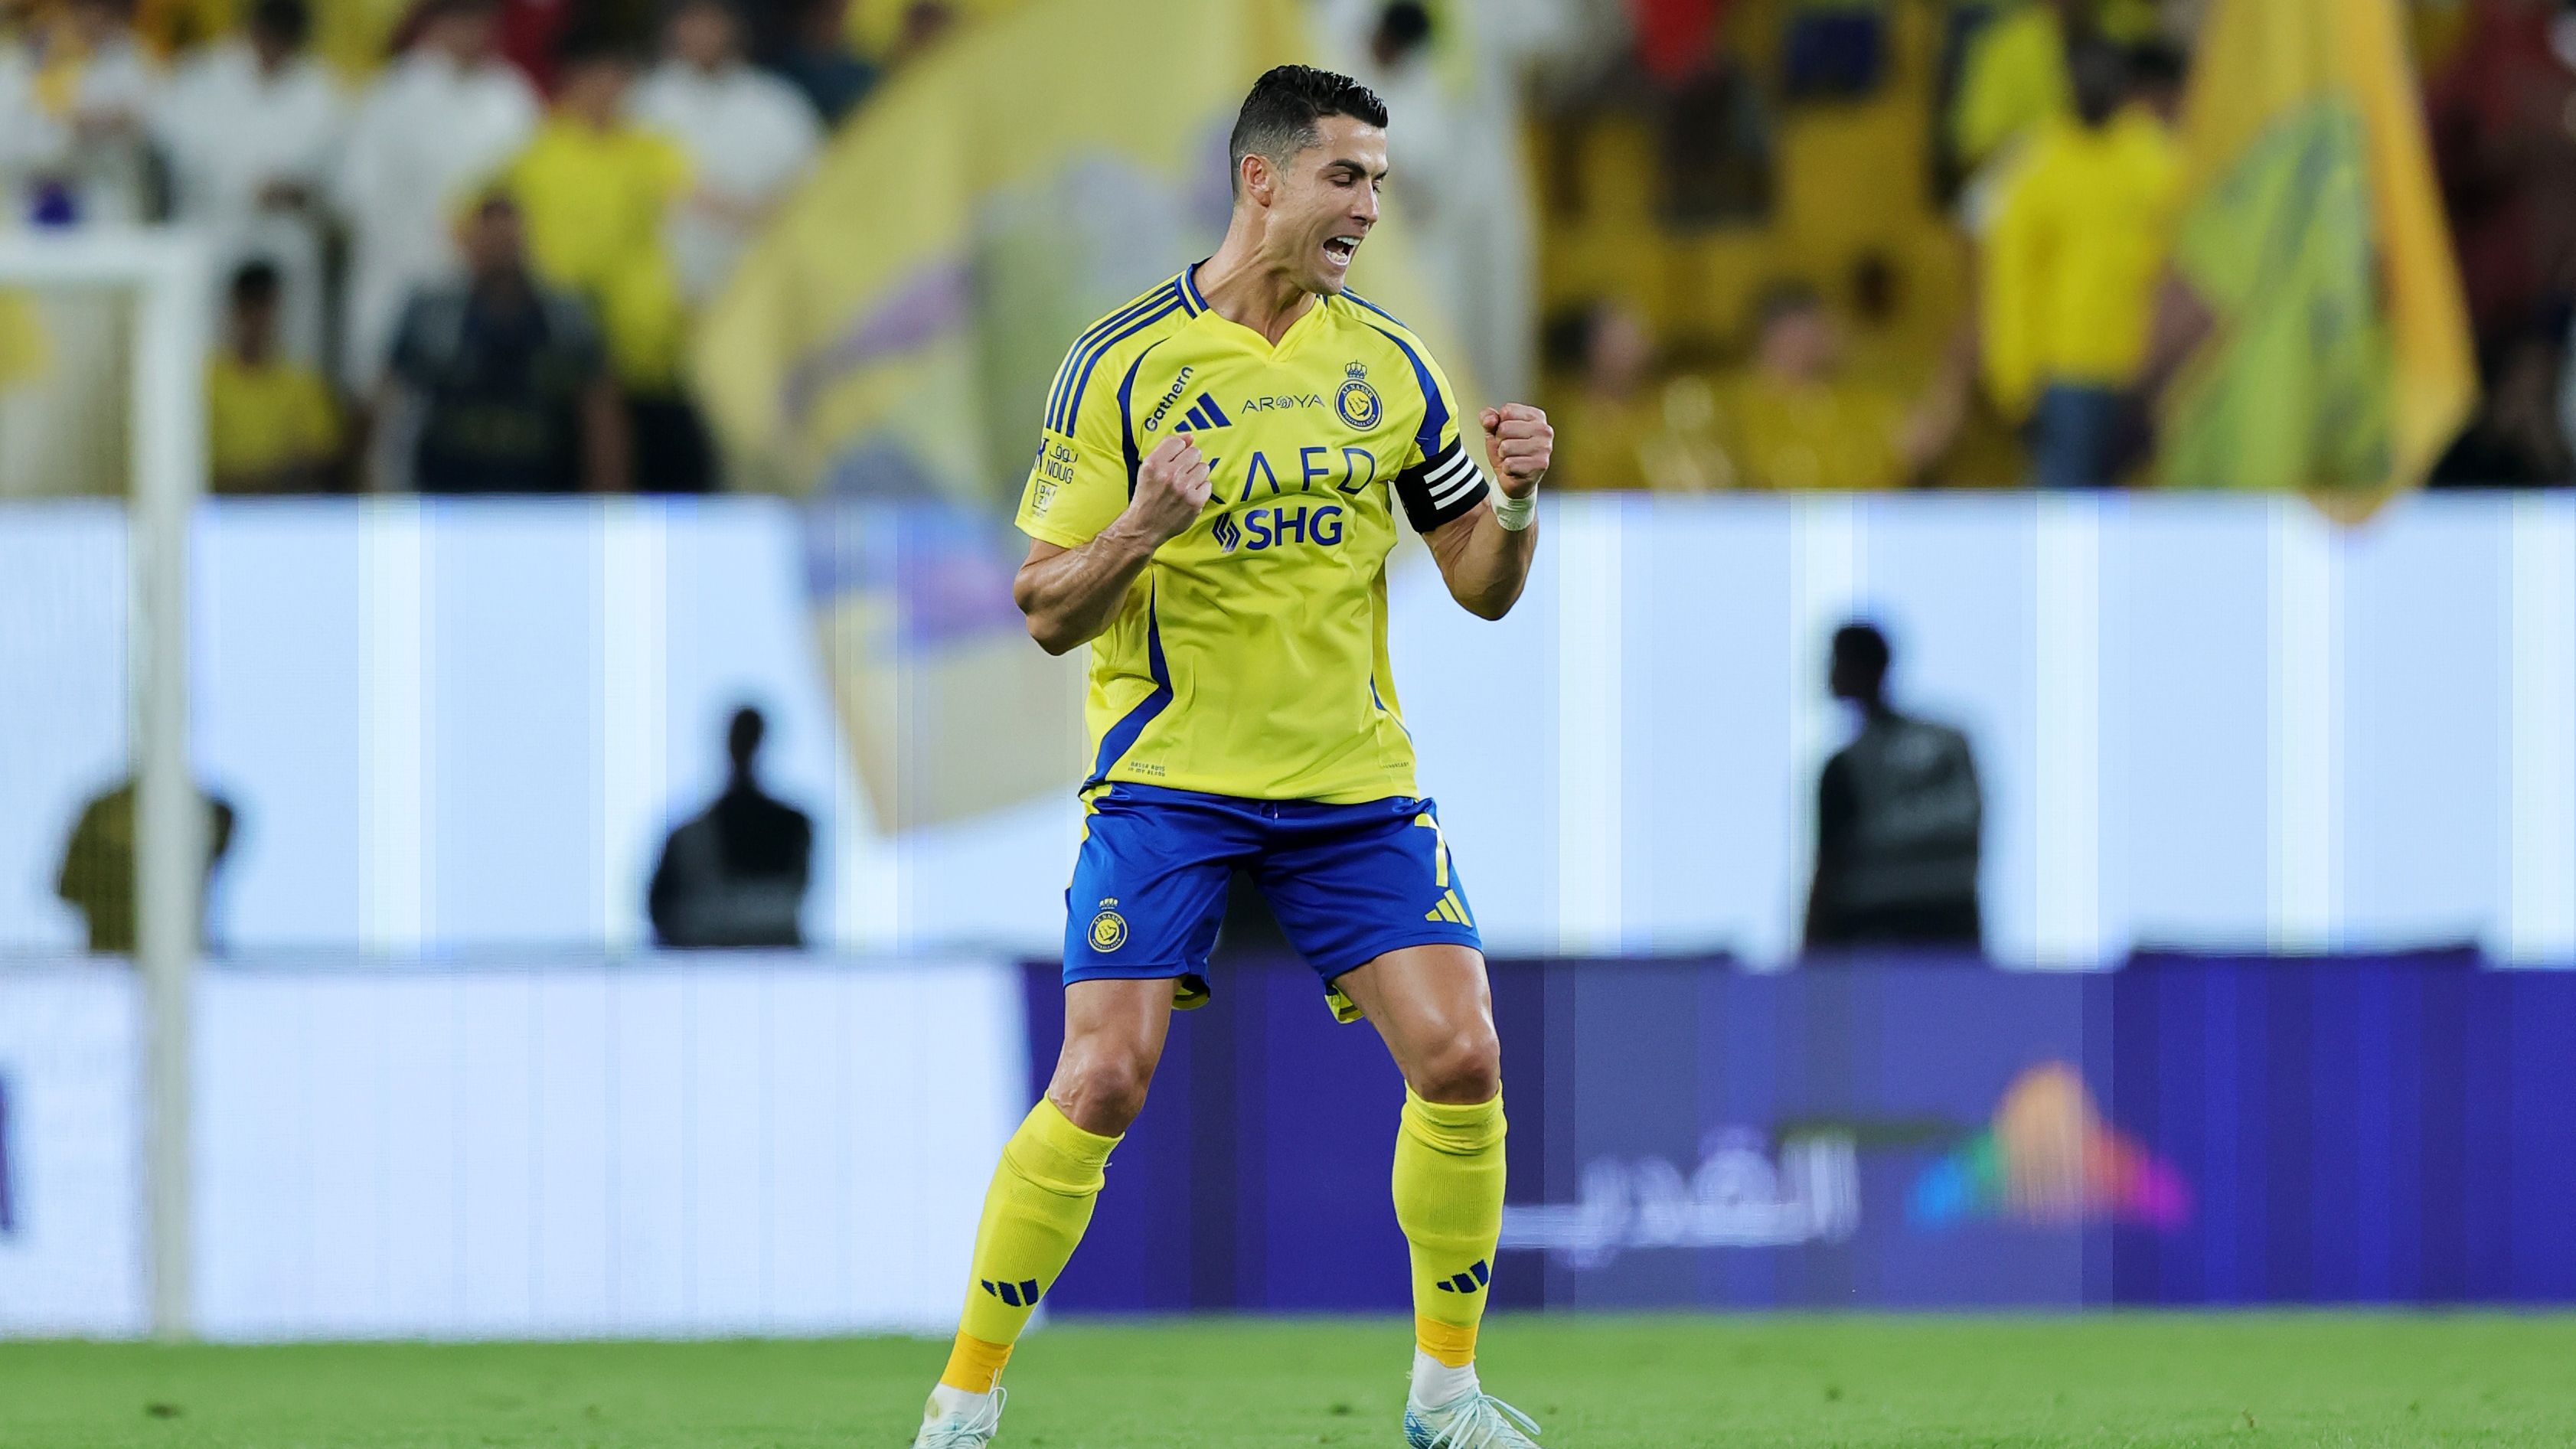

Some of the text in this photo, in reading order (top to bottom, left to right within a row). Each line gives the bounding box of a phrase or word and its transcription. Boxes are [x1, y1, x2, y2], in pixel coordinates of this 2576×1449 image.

[1144, 365, 1193, 432] Gathern
[1241, 394, 1326, 414] AROYA
[1045, 459, 1074, 485] NOUG
[1245, 506, 1343, 550] SHG
[1414, 813, 1449, 888] 7
